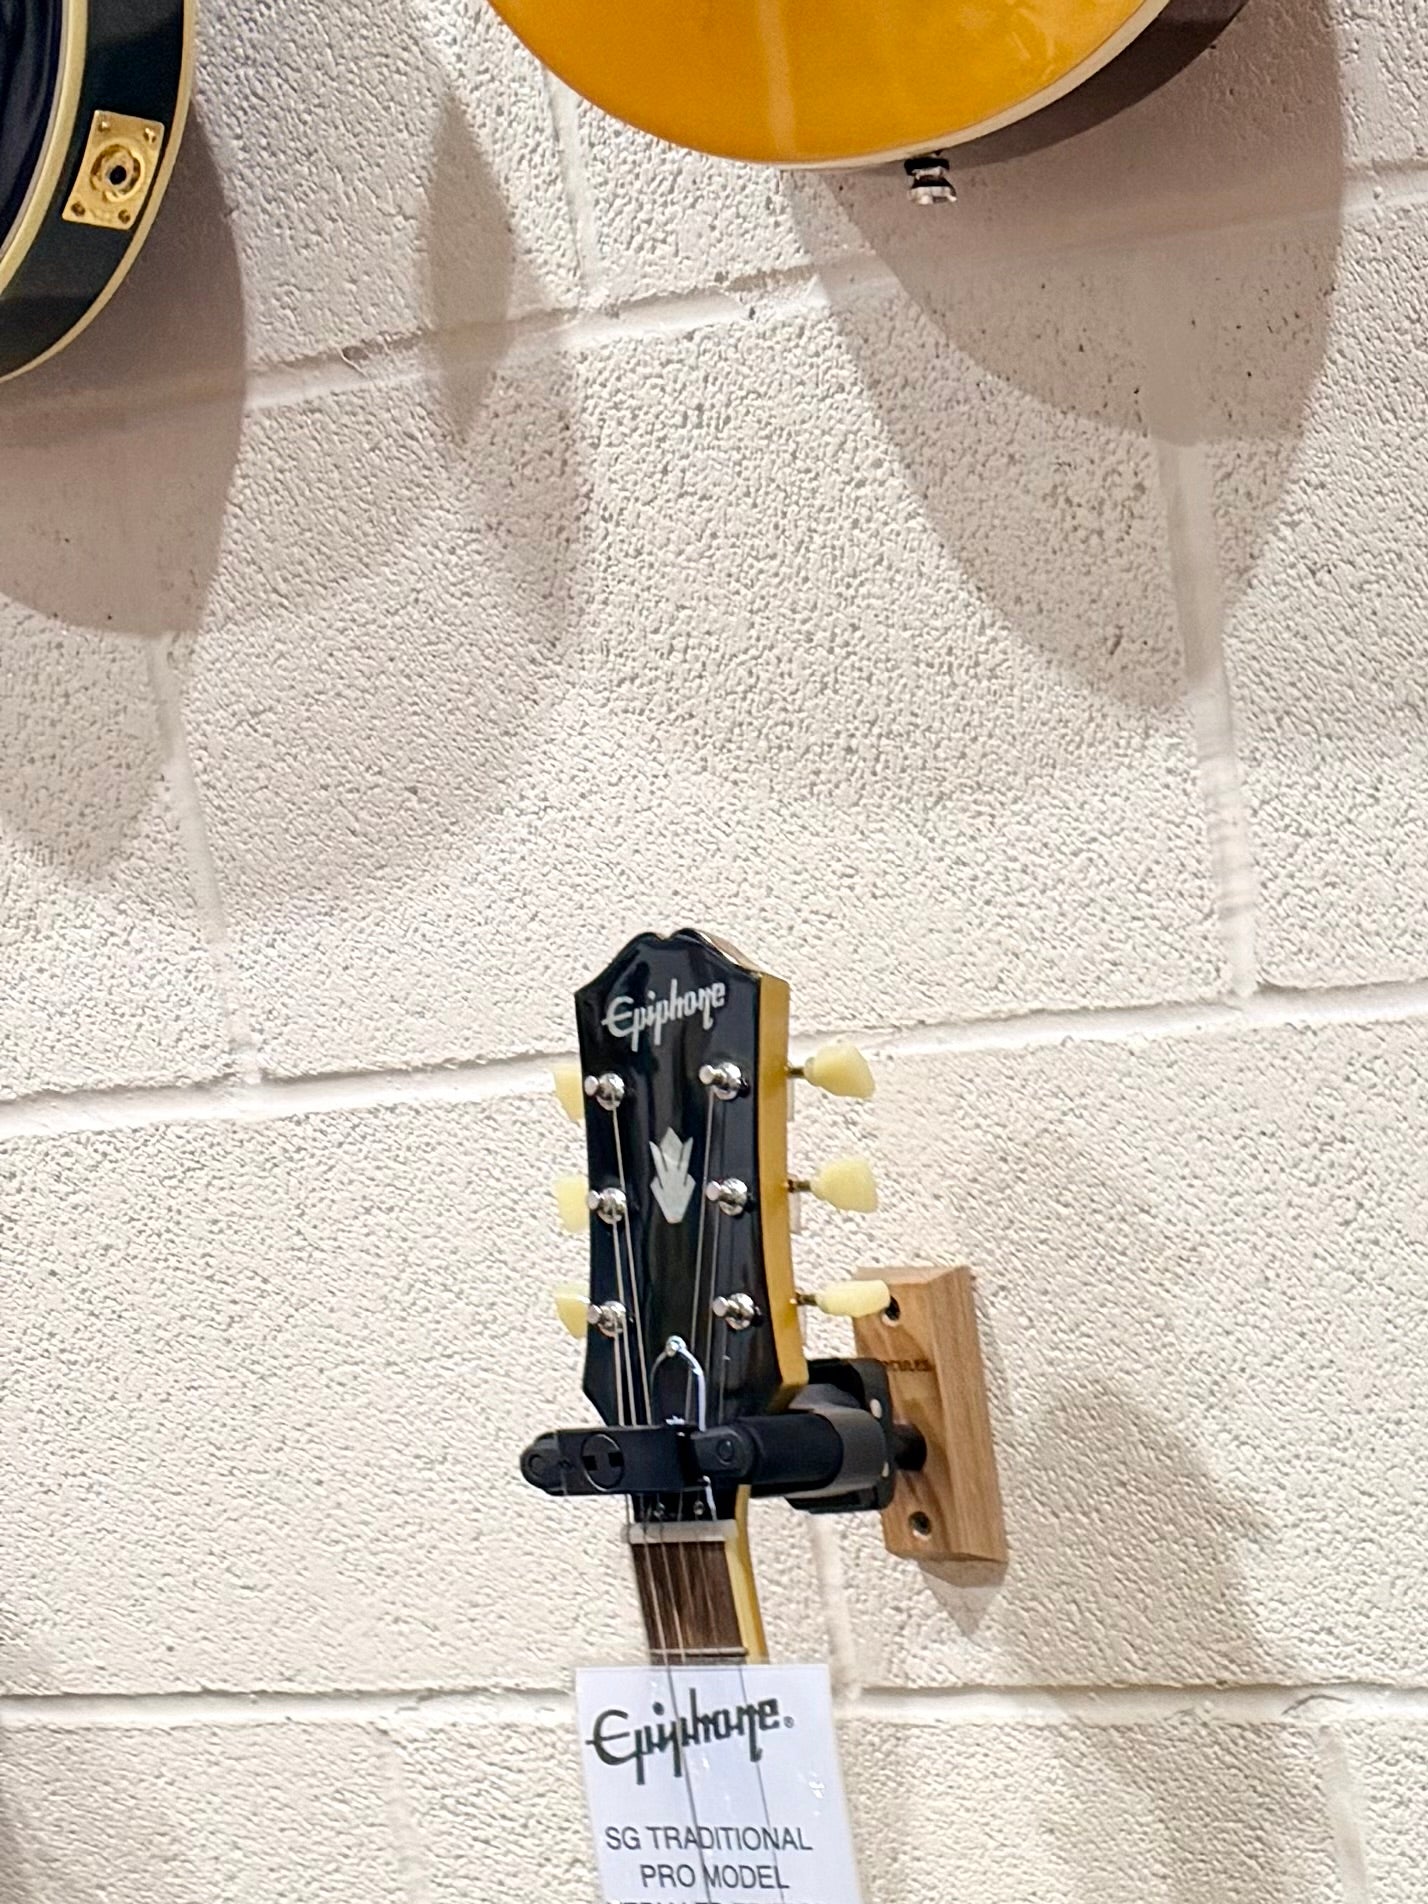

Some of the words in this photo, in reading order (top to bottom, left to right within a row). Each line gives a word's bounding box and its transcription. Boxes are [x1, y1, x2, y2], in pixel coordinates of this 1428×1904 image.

[601, 978, 726, 1053] Epiphone
[605, 1827, 641, 1851] SG
[648, 1826, 813, 1852] TRADITIONAL
[641, 1865, 695, 1888] PRO
[704, 1865, 790, 1889] MODEL
